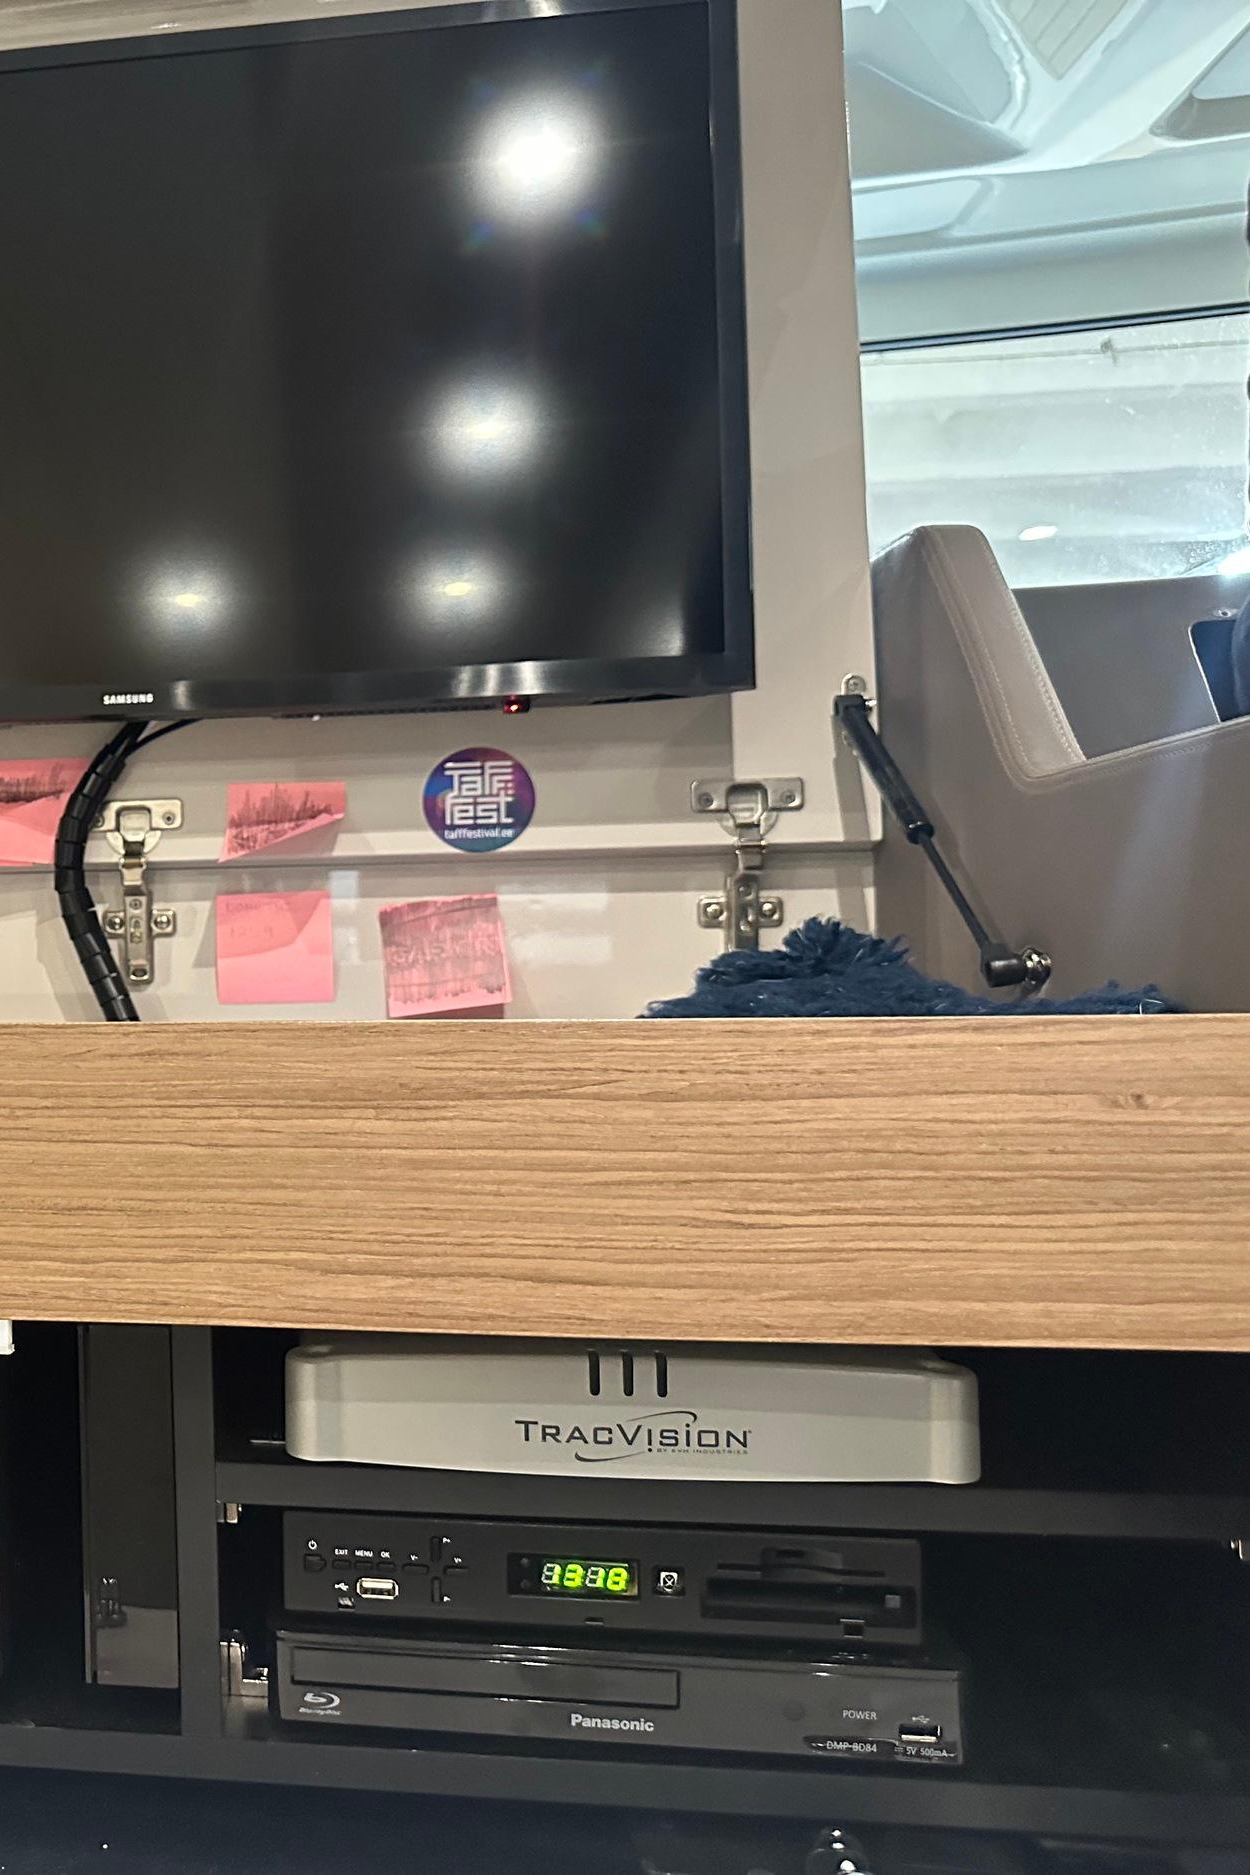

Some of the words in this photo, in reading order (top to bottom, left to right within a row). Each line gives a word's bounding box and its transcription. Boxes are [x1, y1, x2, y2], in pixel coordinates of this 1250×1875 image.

[103, 693, 154, 705] SAMSUNG
[334, 1548, 349, 1557] EXIT
[354, 1549, 374, 1558] MENU
[380, 1551, 391, 1559] OK
[842, 1709, 878, 1721] POWER
[571, 1713, 654, 1732] Panasonic
[826, 1740, 878, 1753] DMP-BD84
[906, 1746, 917, 1757] 5V
[920, 1748, 948, 1759] 500mA
